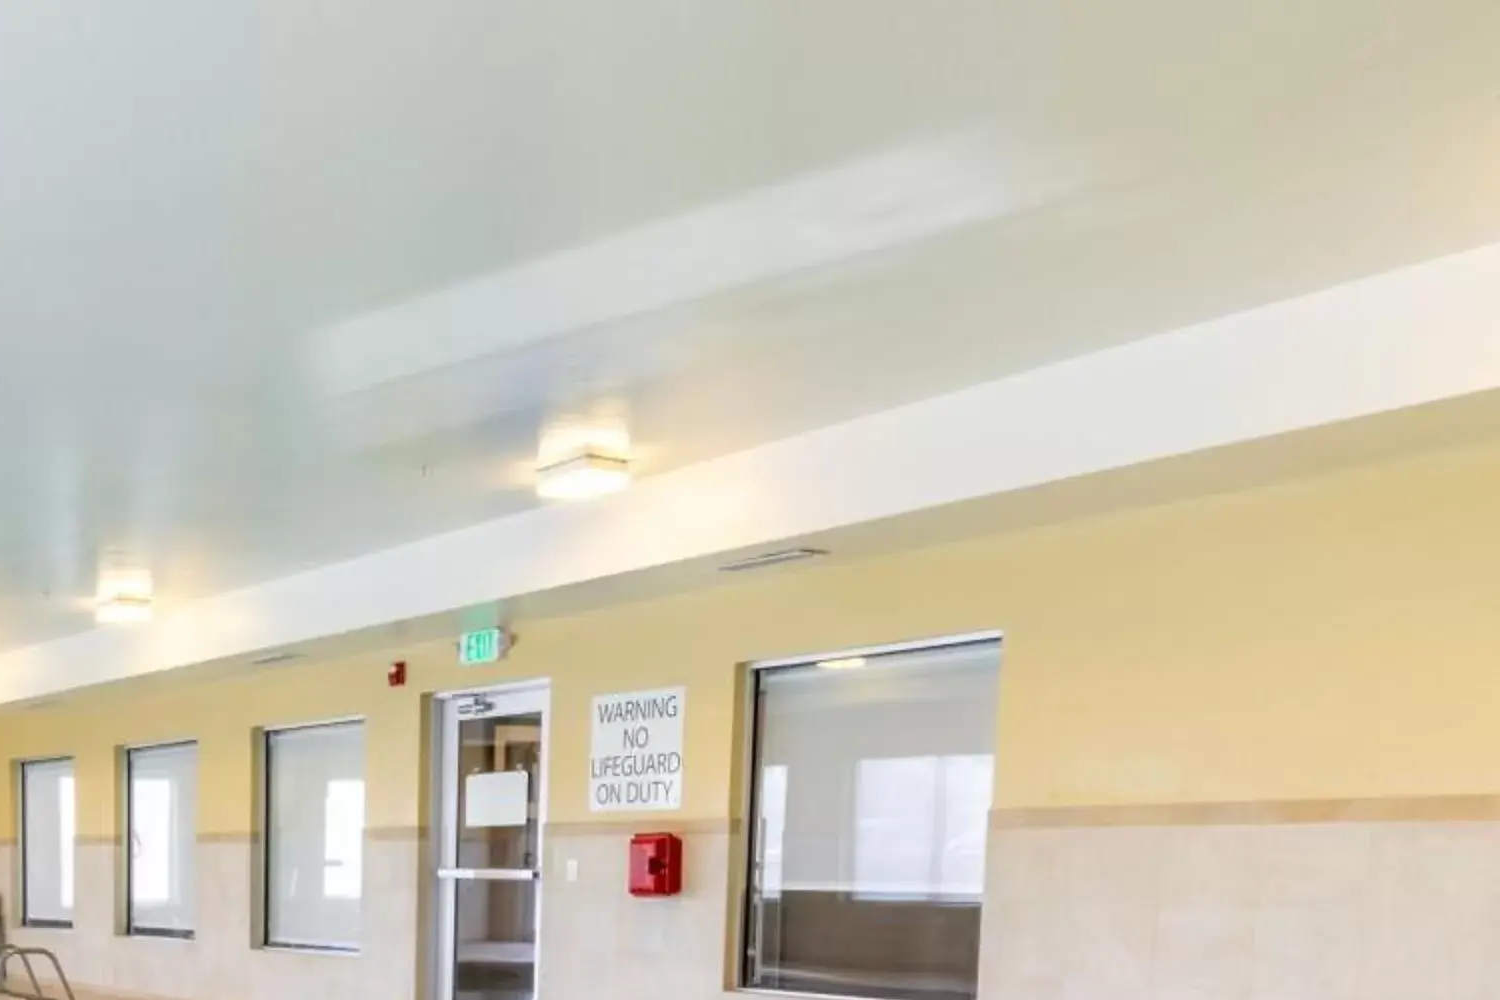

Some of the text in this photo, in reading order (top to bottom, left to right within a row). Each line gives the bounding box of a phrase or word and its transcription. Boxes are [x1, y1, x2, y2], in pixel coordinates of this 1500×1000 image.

[597, 695, 678, 724] WARNING
[622, 726, 649, 749] NO
[590, 751, 682, 779] LIFEGUARD
[596, 780, 674, 805] ON DUTY
